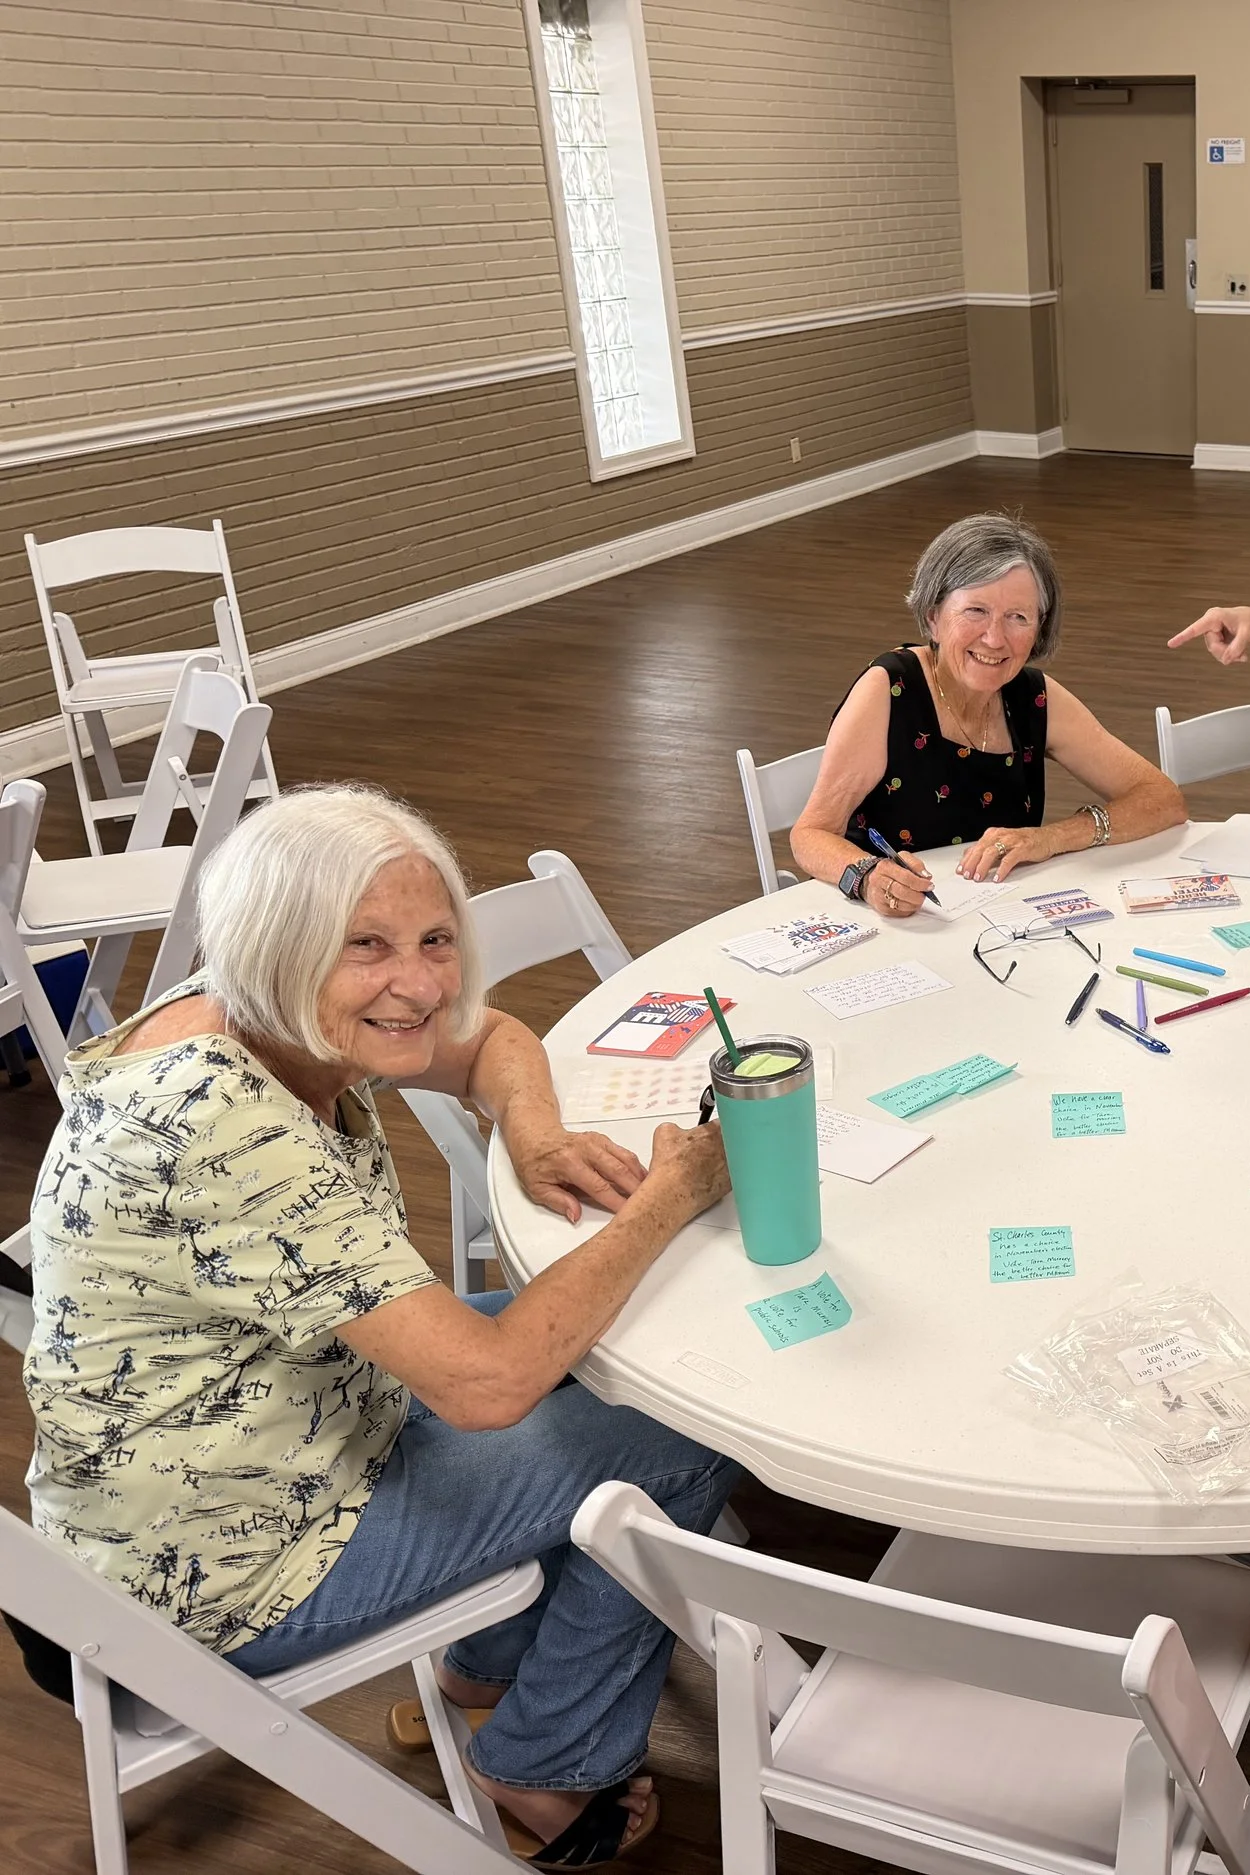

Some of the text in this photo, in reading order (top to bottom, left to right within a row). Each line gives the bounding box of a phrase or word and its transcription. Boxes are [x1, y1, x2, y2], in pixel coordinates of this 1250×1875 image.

[1163, 891, 1207, 900] HEROES
[1037, 901, 1100, 919] VOTE
[1052, 1095, 1066, 1106] We
[1071, 1095, 1088, 1103] have
[1006, 1230, 1035, 1240] Charles
[1040, 1229, 1066, 1239] County
[808, 1280, 841, 1313] A vote for
[769, 1303, 785, 1317] vote
[785, 1318, 798, 1328] for
[793, 1289, 835, 1329] Tara Murray
[750, 1307, 790, 1343] public schools
[1137, 1334, 1180, 1356] SEPARATE
[1145, 1345, 1183, 1365] DO NOT
[1180, 1348, 1201, 1361] This
[1136, 1367, 1153, 1378] Set
[1155, 1364, 1163, 1373] A
